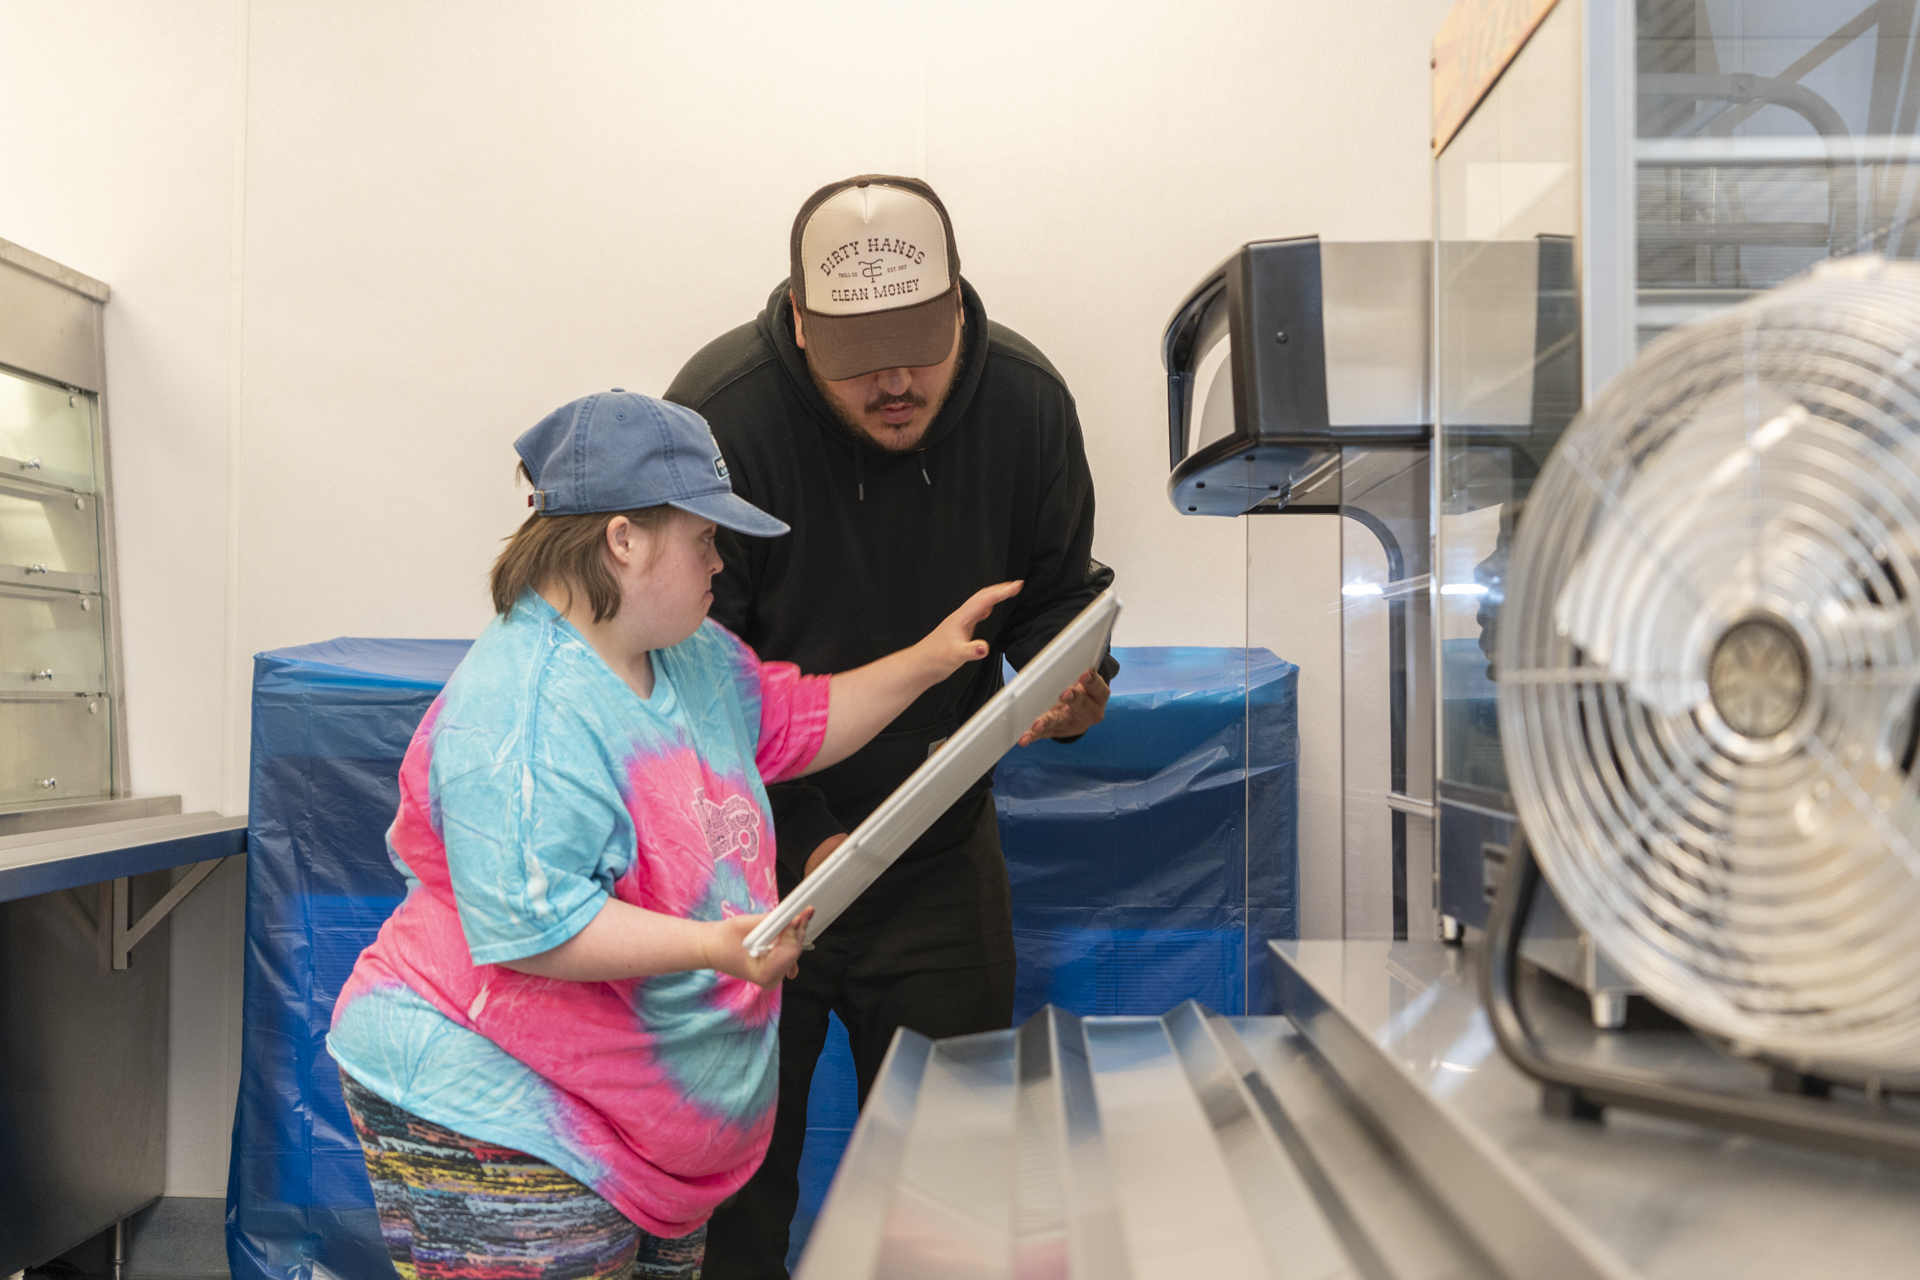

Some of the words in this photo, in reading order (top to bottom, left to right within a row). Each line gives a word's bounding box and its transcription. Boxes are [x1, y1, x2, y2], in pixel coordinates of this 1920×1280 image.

[820, 240, 860, 277] DIRTY
[867, 237, 926, 265] HANDS
[831, 287, 869, 302] CLEAN
[873, 278, 920, 299] MONEY
